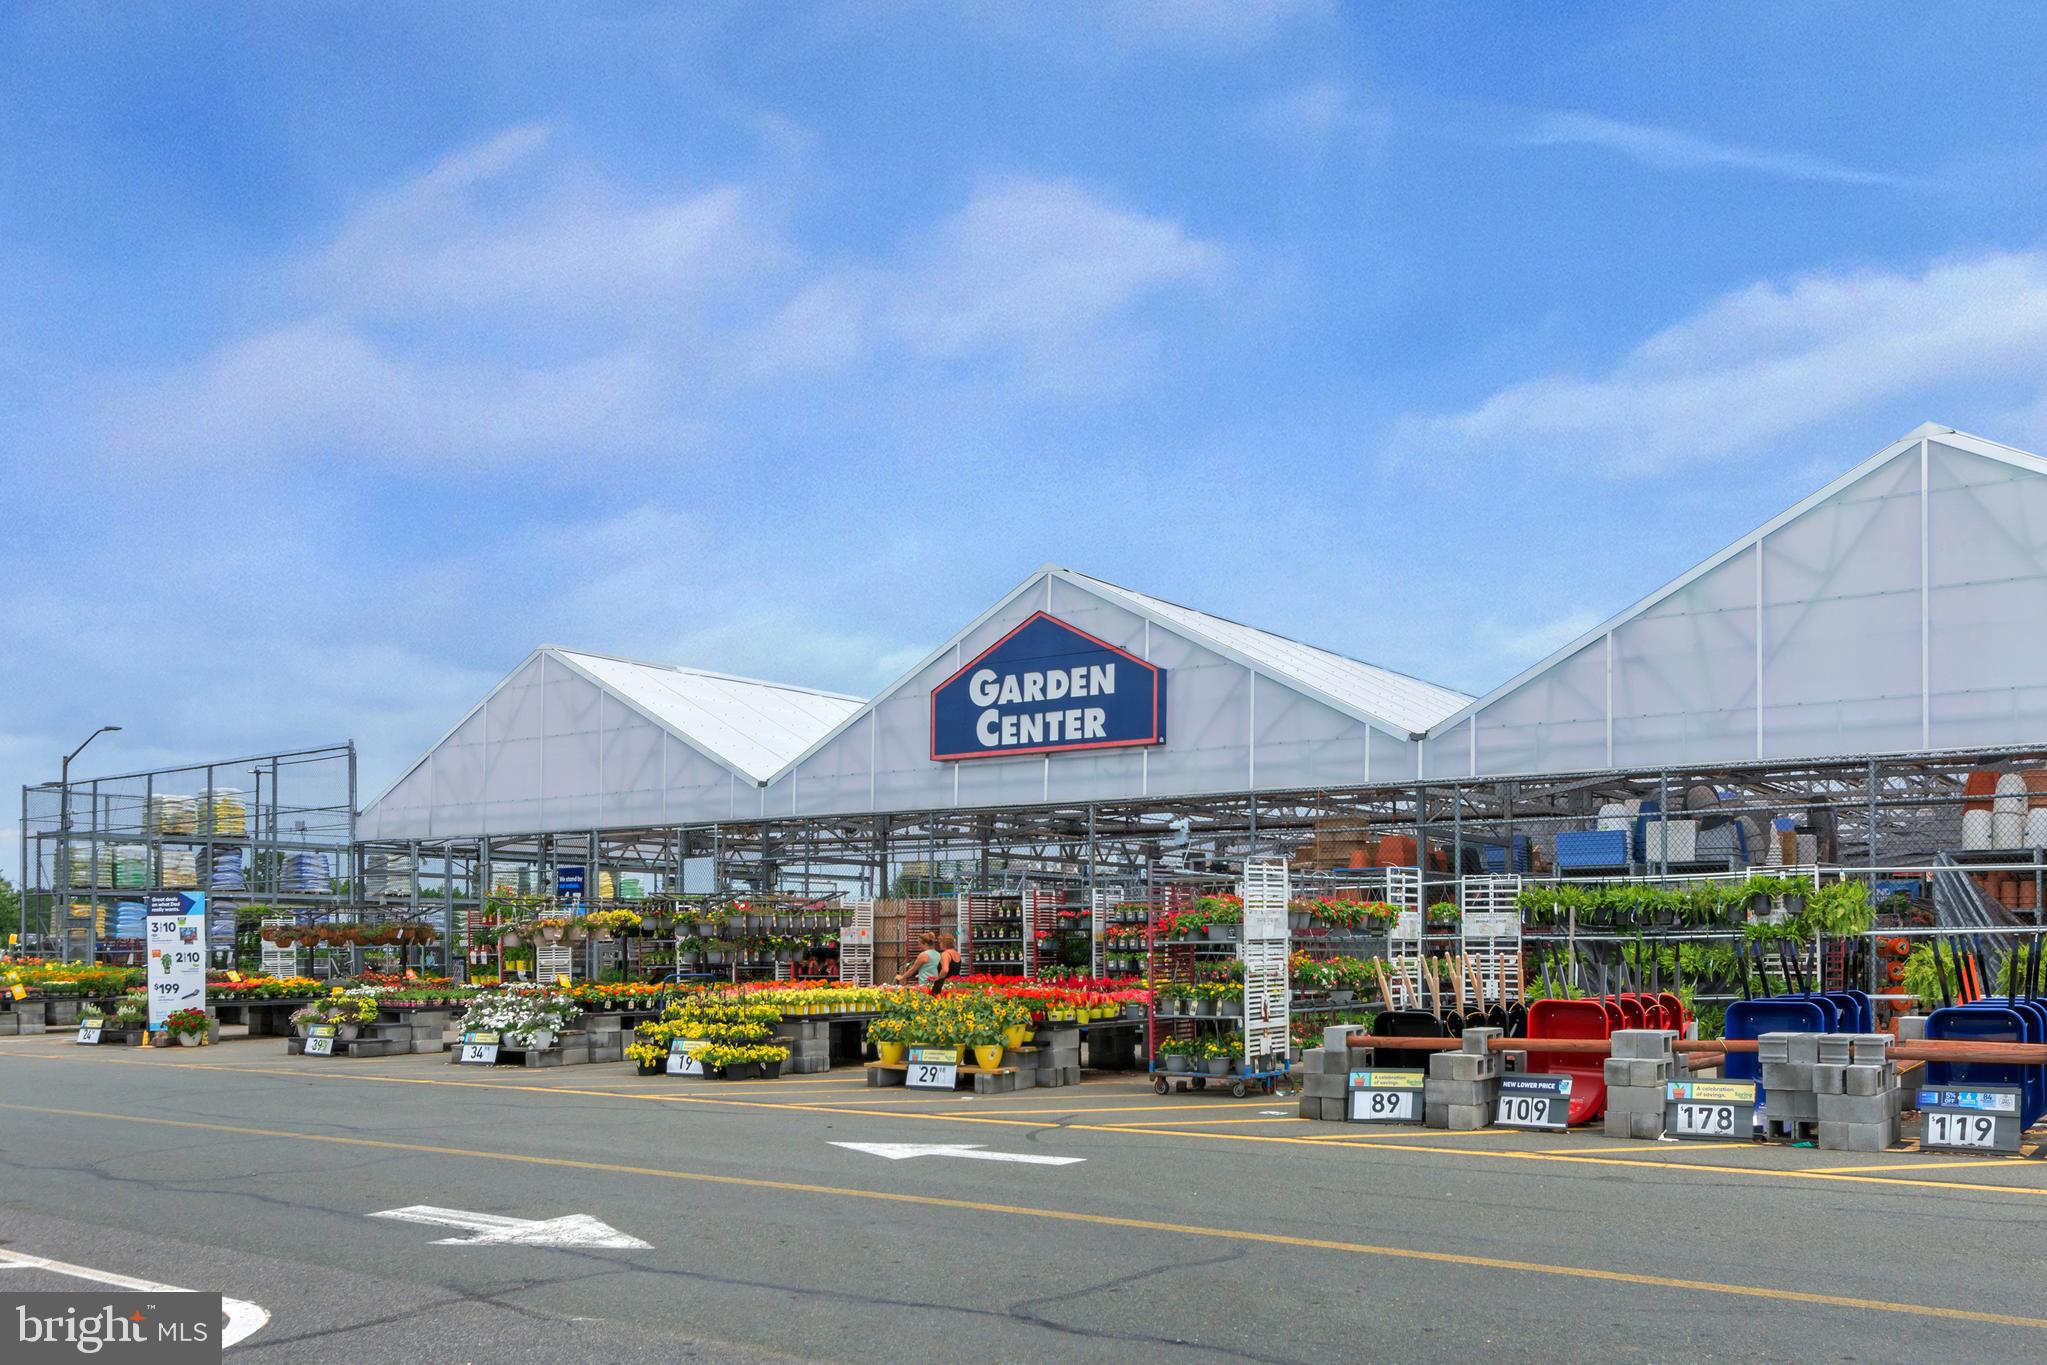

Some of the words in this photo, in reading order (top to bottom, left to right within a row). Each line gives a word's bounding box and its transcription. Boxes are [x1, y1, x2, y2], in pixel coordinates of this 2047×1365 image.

[969, 663, 1115, 707] GARDEN
[976, 707, 1107, 747] CENTER
[152, 922, 159, 932] 3
[176, 952, 183, 962] 2
[154, 983, 180, 994] $199
[470, 1046, 483, 1059] 34
[680, 1055, 693, 1071] 19
[919, 1066, 938, 1083] 29
[1372, 1093, 1400, 1113] 89
[1680, 1106, 1732, 1130] $178
[1931, 1116, 1993, 1141] $119
